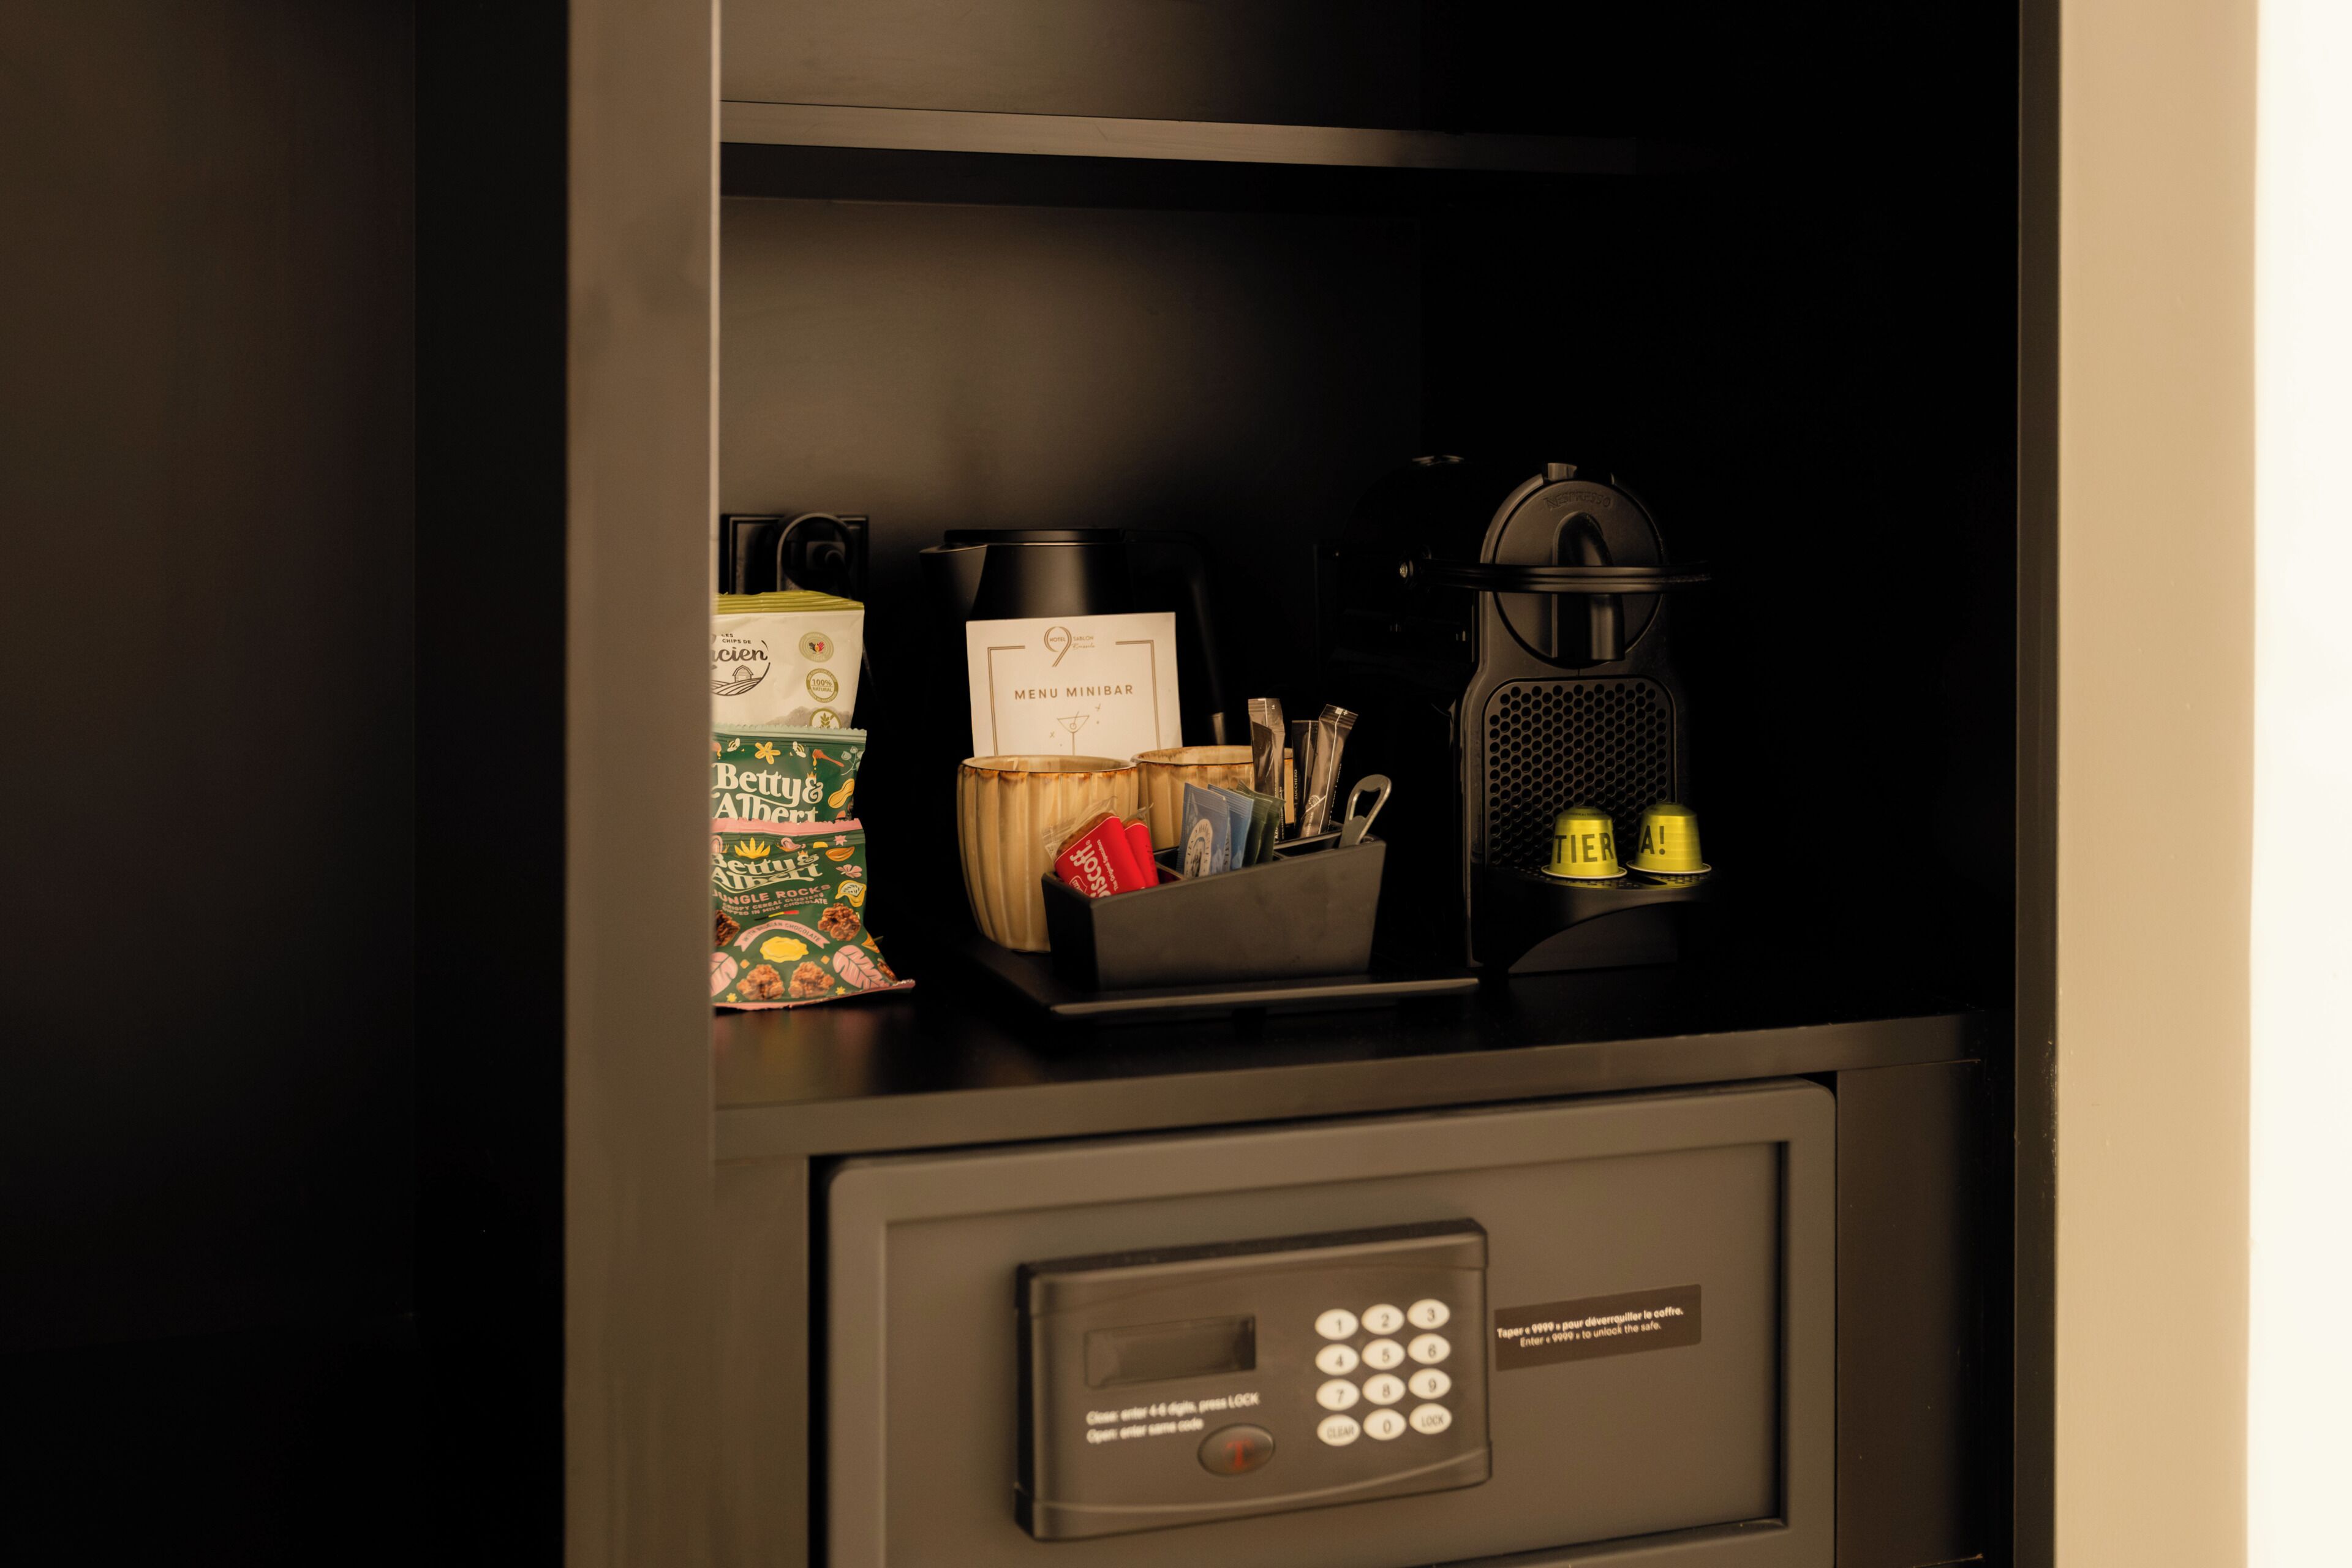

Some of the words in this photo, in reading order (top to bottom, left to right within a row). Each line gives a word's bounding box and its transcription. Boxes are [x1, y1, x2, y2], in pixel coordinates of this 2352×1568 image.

[1014, 687, 1058, 699] MENU
[1066, 685, 1134, 697] MINIBAR
[1096, 839, 1109, 864] Speculoos
[711, 864, 823, 893] Albert
[1104, 862, 1115, 882] Original
[712, 889, 770, 905] JUNGLE
[775, 884, 831, 899] ROCKS
[753, 900, 783, 910] CEREAL
[785, 923, 821, 942] CHOCOLATE
[1381, 1314, 1390, 1327] 2
[1427, 1308, 1435, 1322] 3
[1497, 1327, 1523, 1338] Taper
[1532, 1322, 1554, 1333] 9999
[1562, 1320, 1583, 1331] pour
[1643, 1310, 1652, 1319] le
[1654, 1306, 1684, 1318] coffre.
[1336, 1319, 1342, 1333] 1
[1520, 1336, 1544, 1348] Enter
[1552, 1332, 1573, 1343] 9999
[1582, 1330, 1591, 1339] to
[1593, 1324, 1623, 1338] unlock
[1624, 1323, 1639, 1333] the
[1641, 1321, 1661, 1330] safe.
[1382, 1348, 1390, 1362] 5
[1428, 1343, 1436, 1357] 6
[1335, 1354, 1343, 1367] 4
[1382, 1384, 1390, 1397] 8
[1428, 1378, 1437, 1392] 9
[1336, 1389, 1344, 1403] 7
[1085, 1410, 1120, 1427] Close:
[1121, 1406, 1148, 1422] enter
[1169, 1399, 1198, 1417] digits,
[1199, 1396, 1227, 1415] press
[1227, 1392, 1261, 1408] LOCK
[1383, 1420, 1391, 1434] 0
[1422, 1414, 1444, 1427] LOCK
[1087, 1428, 1120, 1445] Open:
[1120, 1425, 1148, 1440] enter
[1148, 1422, 1176, 1436] same
[1177, 1417, 1204, 1433] code
[1327, 1426, 1354, 1438] CLEAR
